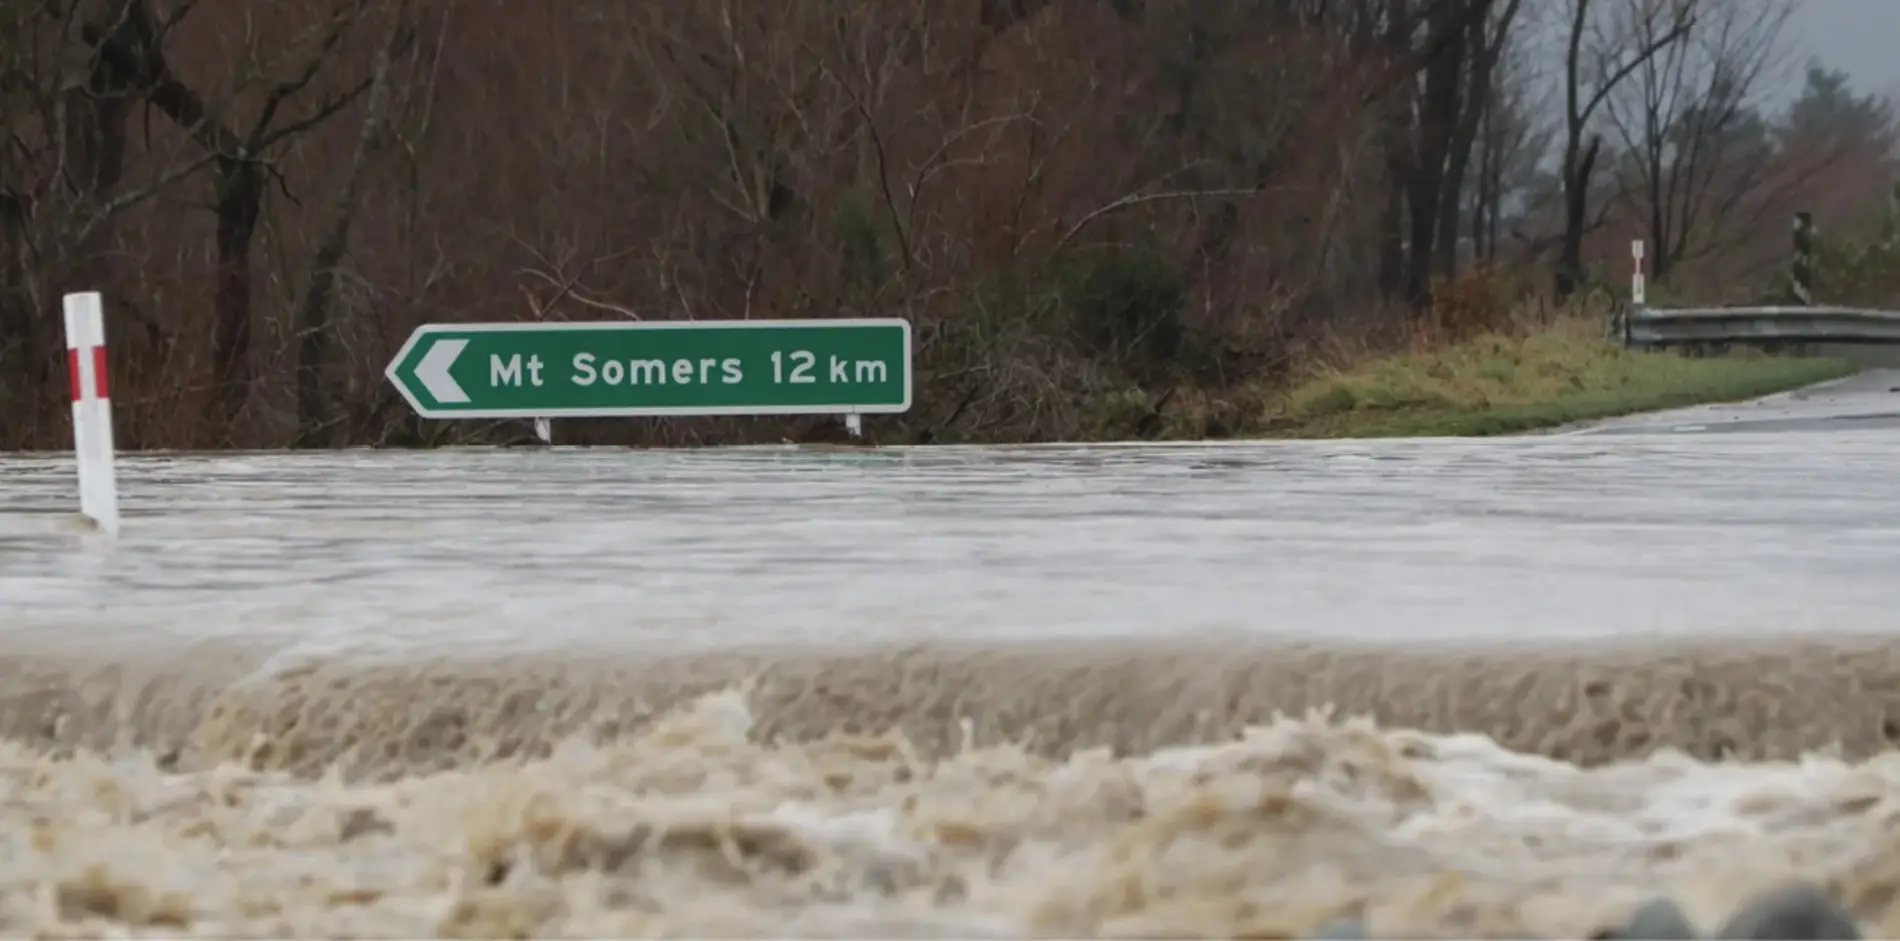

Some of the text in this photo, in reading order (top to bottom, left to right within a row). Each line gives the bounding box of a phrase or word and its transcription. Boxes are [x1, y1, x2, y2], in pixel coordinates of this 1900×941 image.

[489, 350, 888, 387] Mt Somers 12 km
